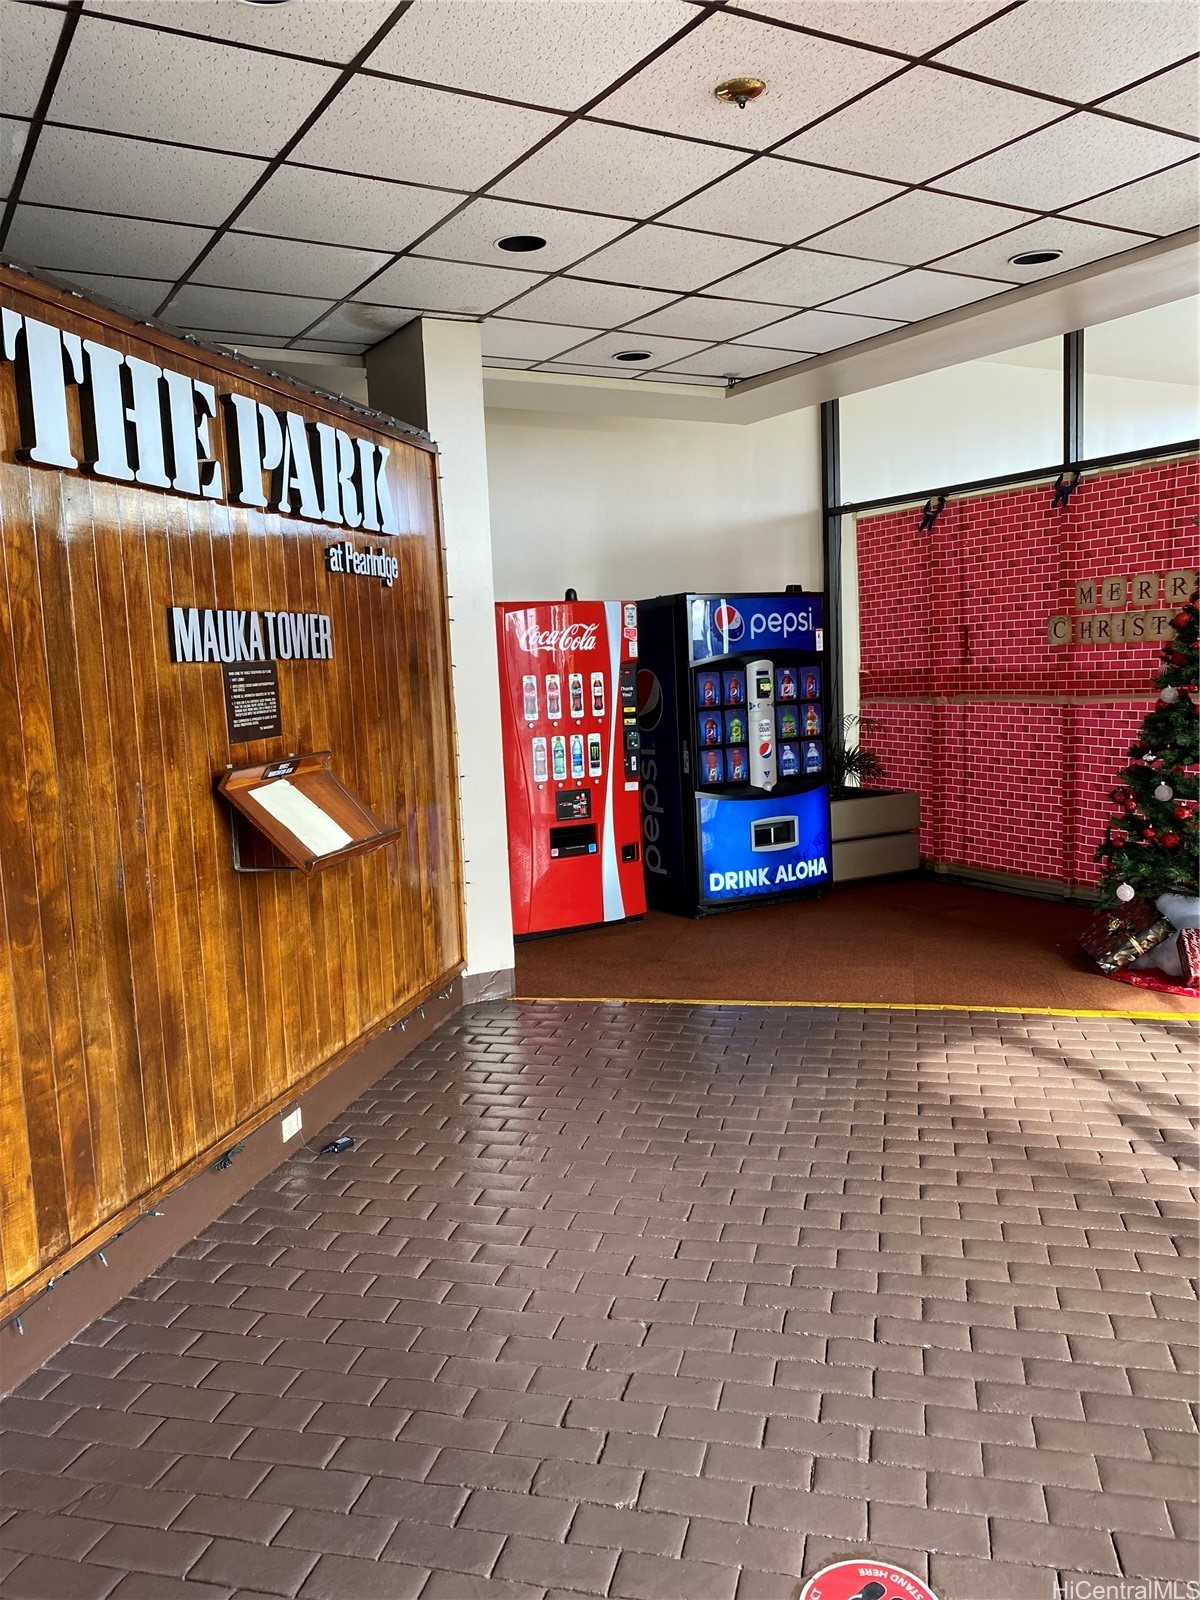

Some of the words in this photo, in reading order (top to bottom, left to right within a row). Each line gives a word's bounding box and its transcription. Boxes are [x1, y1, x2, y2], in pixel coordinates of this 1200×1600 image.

[1, 307, 224, 499] THE
[231, 393, 399, 536] PARK
[329, 543, 344, 572] at
[1079, 577, 1189, 604] MERR
[172, 607, 265, 663] MAUKA
[264, 611, 334, 660] TOWER
[519, 622, 600, 652] Coca-Cola
[750, 606, 813, 640] pepsi
[1053, 615, 1168, 639] CHRIST
[640, 748, 668, 875] pepsi
[709, 867, 771, 892] DRINK
[775, 857, 828, 884] ALOHA
[857, 1567, 889, 1578] HERE
[889, 1574, 924, 1600] STAND
